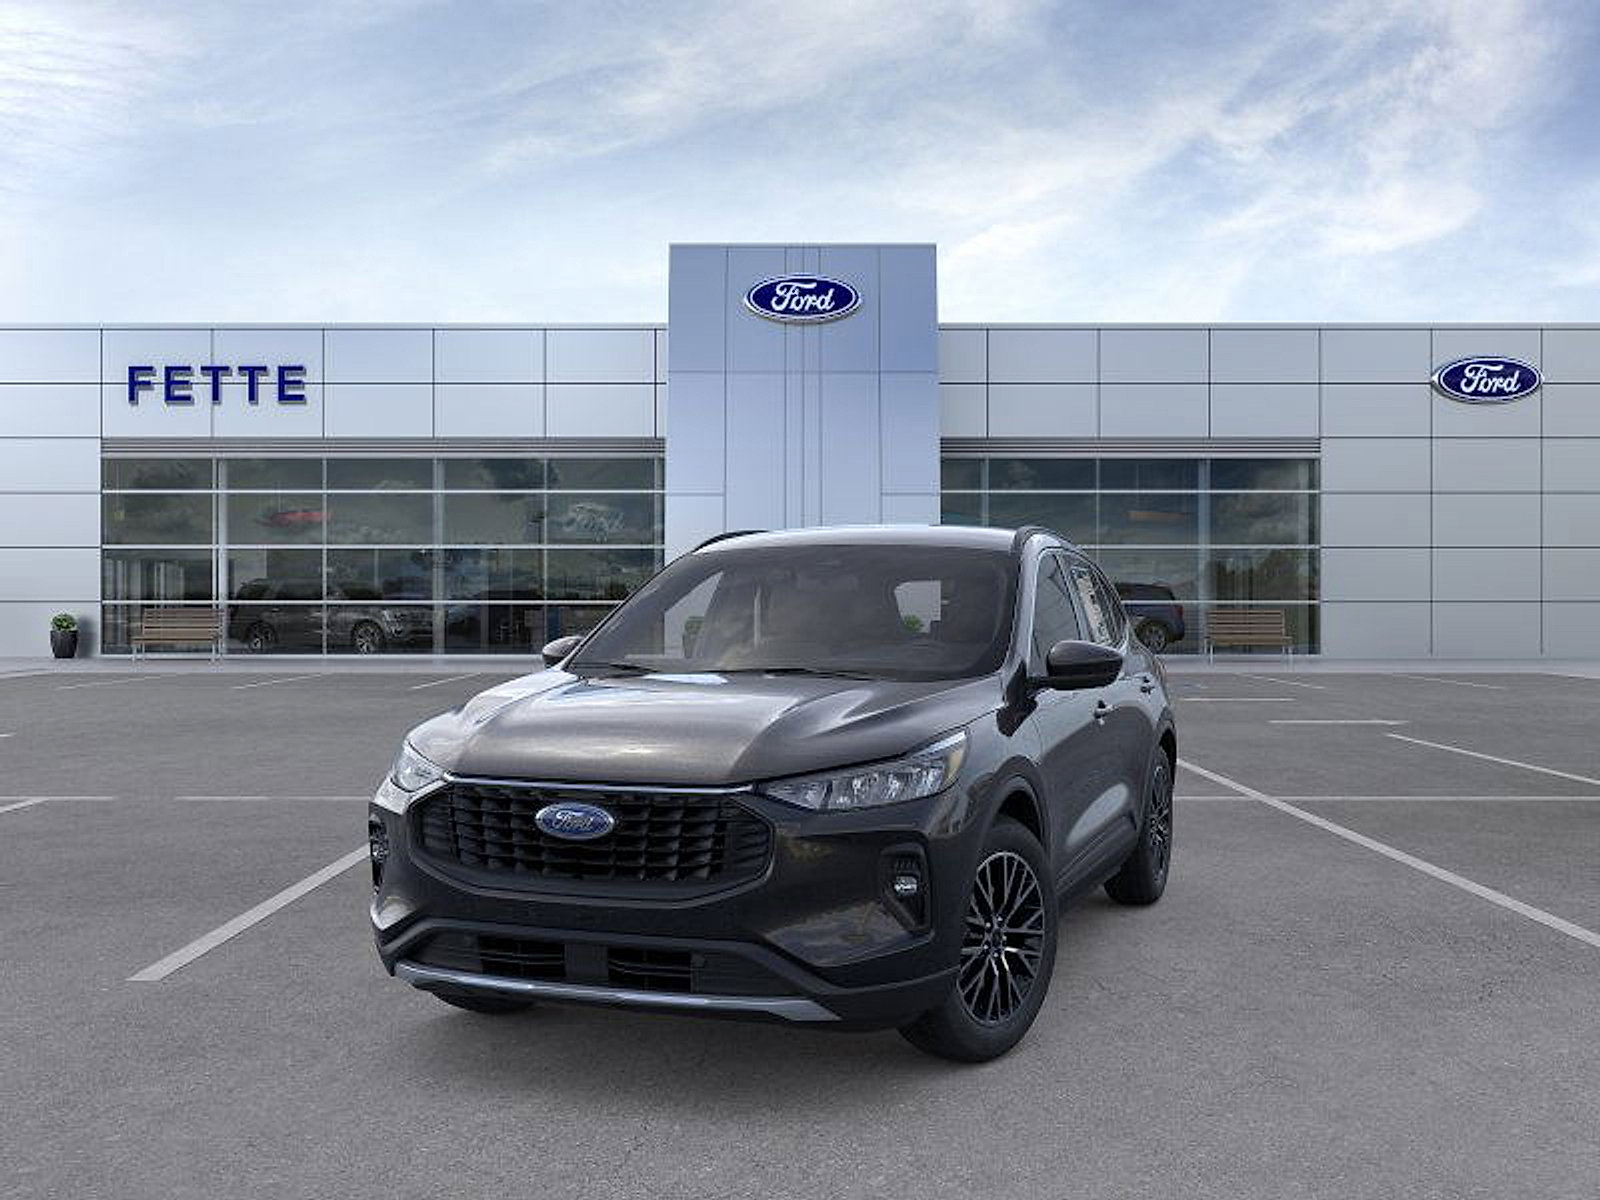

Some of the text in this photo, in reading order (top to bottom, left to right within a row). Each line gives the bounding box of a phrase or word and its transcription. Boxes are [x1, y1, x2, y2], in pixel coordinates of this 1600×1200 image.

[771, 281, 835, 311] Ford
[127, 365, 307, 405] FETTE
[1460, 364, 1520, 393] Ford
[552, 810, 595, 830] Ford
